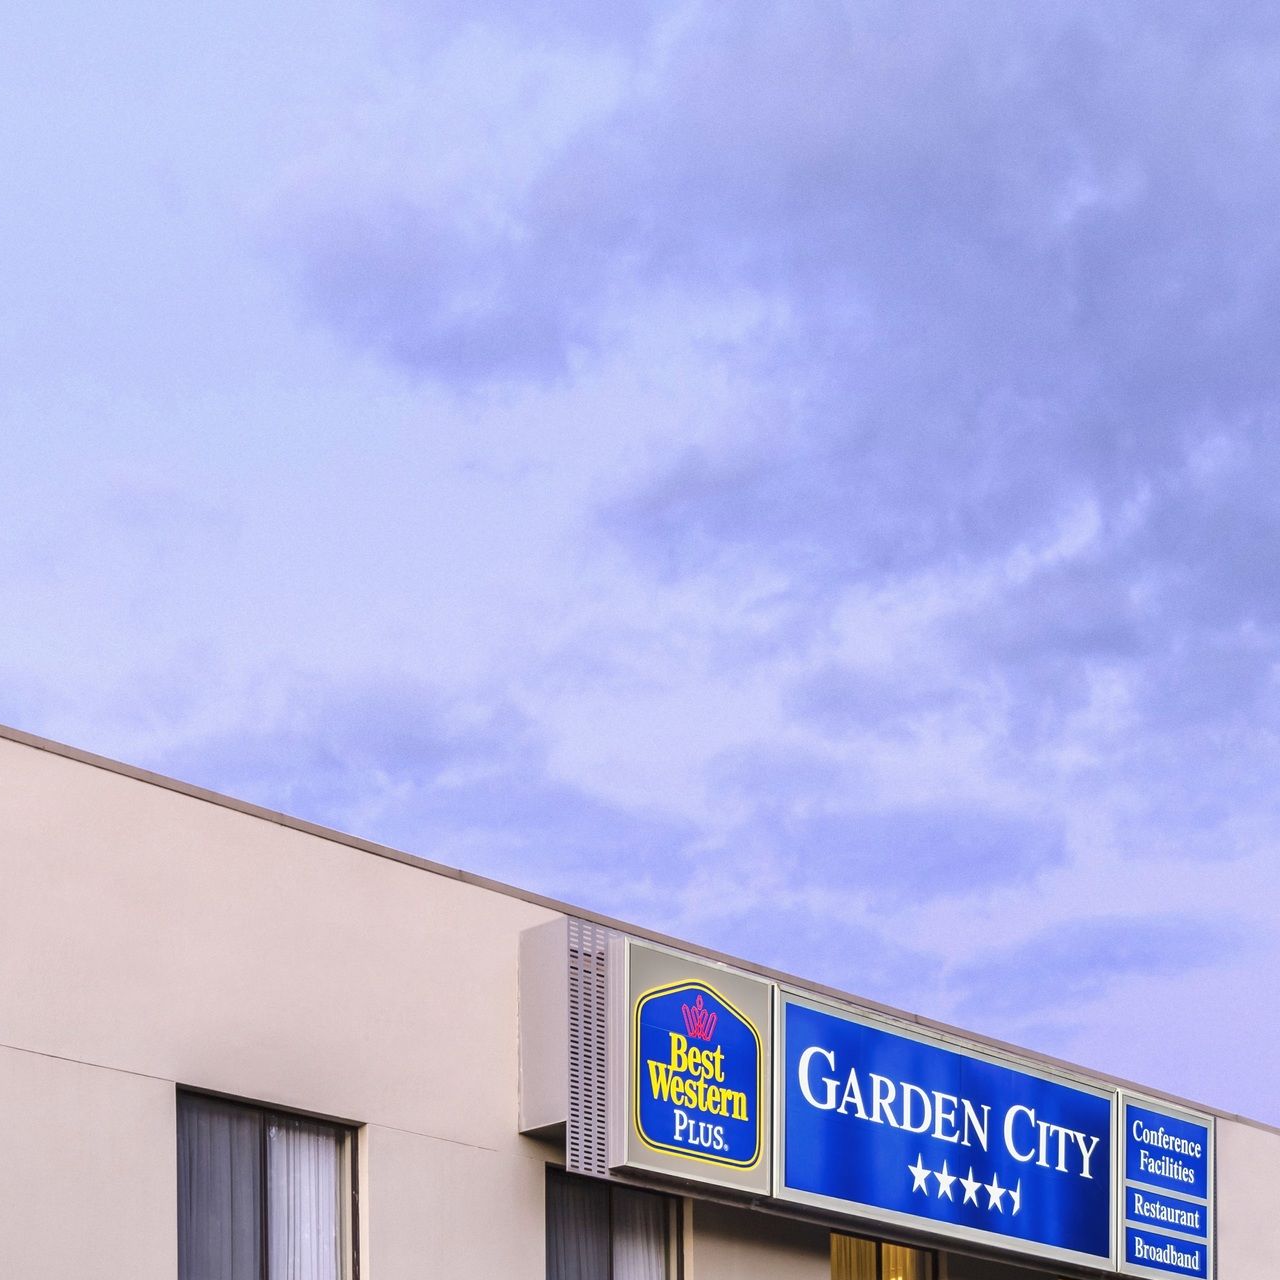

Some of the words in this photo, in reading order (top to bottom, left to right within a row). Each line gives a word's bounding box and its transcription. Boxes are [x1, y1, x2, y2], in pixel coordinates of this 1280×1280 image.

[669, 1032, 724, 1083] Best
[647, 1059, 749, 1121] Western
[798, 1046, 991, 1152] GARDEN
[1003, 1104, 1099, 1179] CITY
[1132, 1120, 1202, 1158] Conference
[1139, 1149, 1195, 1184] Facilities
[1134, 1193, 1200, 1229] Restaurant
[1134, 1236, 1200, 1271] Broadband
